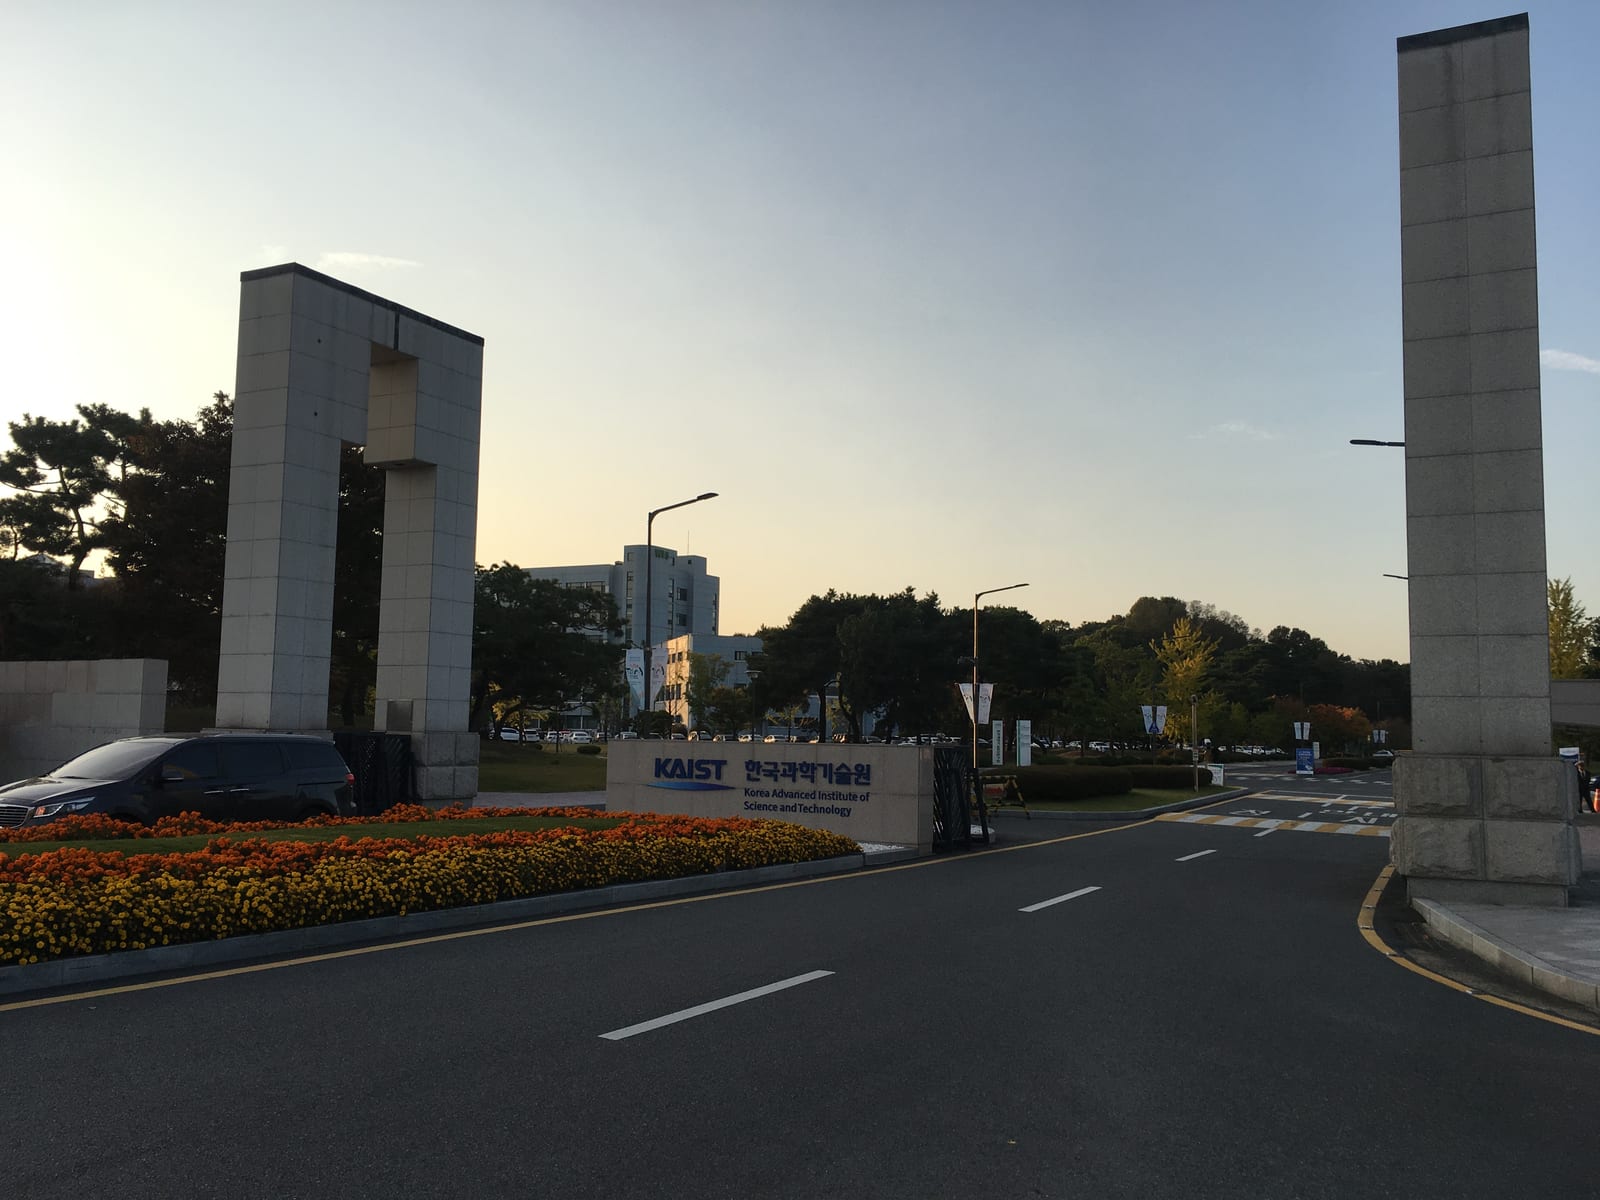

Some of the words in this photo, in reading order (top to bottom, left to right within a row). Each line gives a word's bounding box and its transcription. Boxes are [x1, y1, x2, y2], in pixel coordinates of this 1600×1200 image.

[654, 757, 727, 780] KAIST
[744, 759, 871, 786] 한국과학기술원
[744, 787, 770, 798] Korea
[772, 789, 816, 800] Advanced
[818, 790, 859, 801] Institute
[860, 792, 870, 802] of
[744, 801, 778, 811] Science
[780, 803, 797, 813] and
[798, 804, 852, 817] Technology
